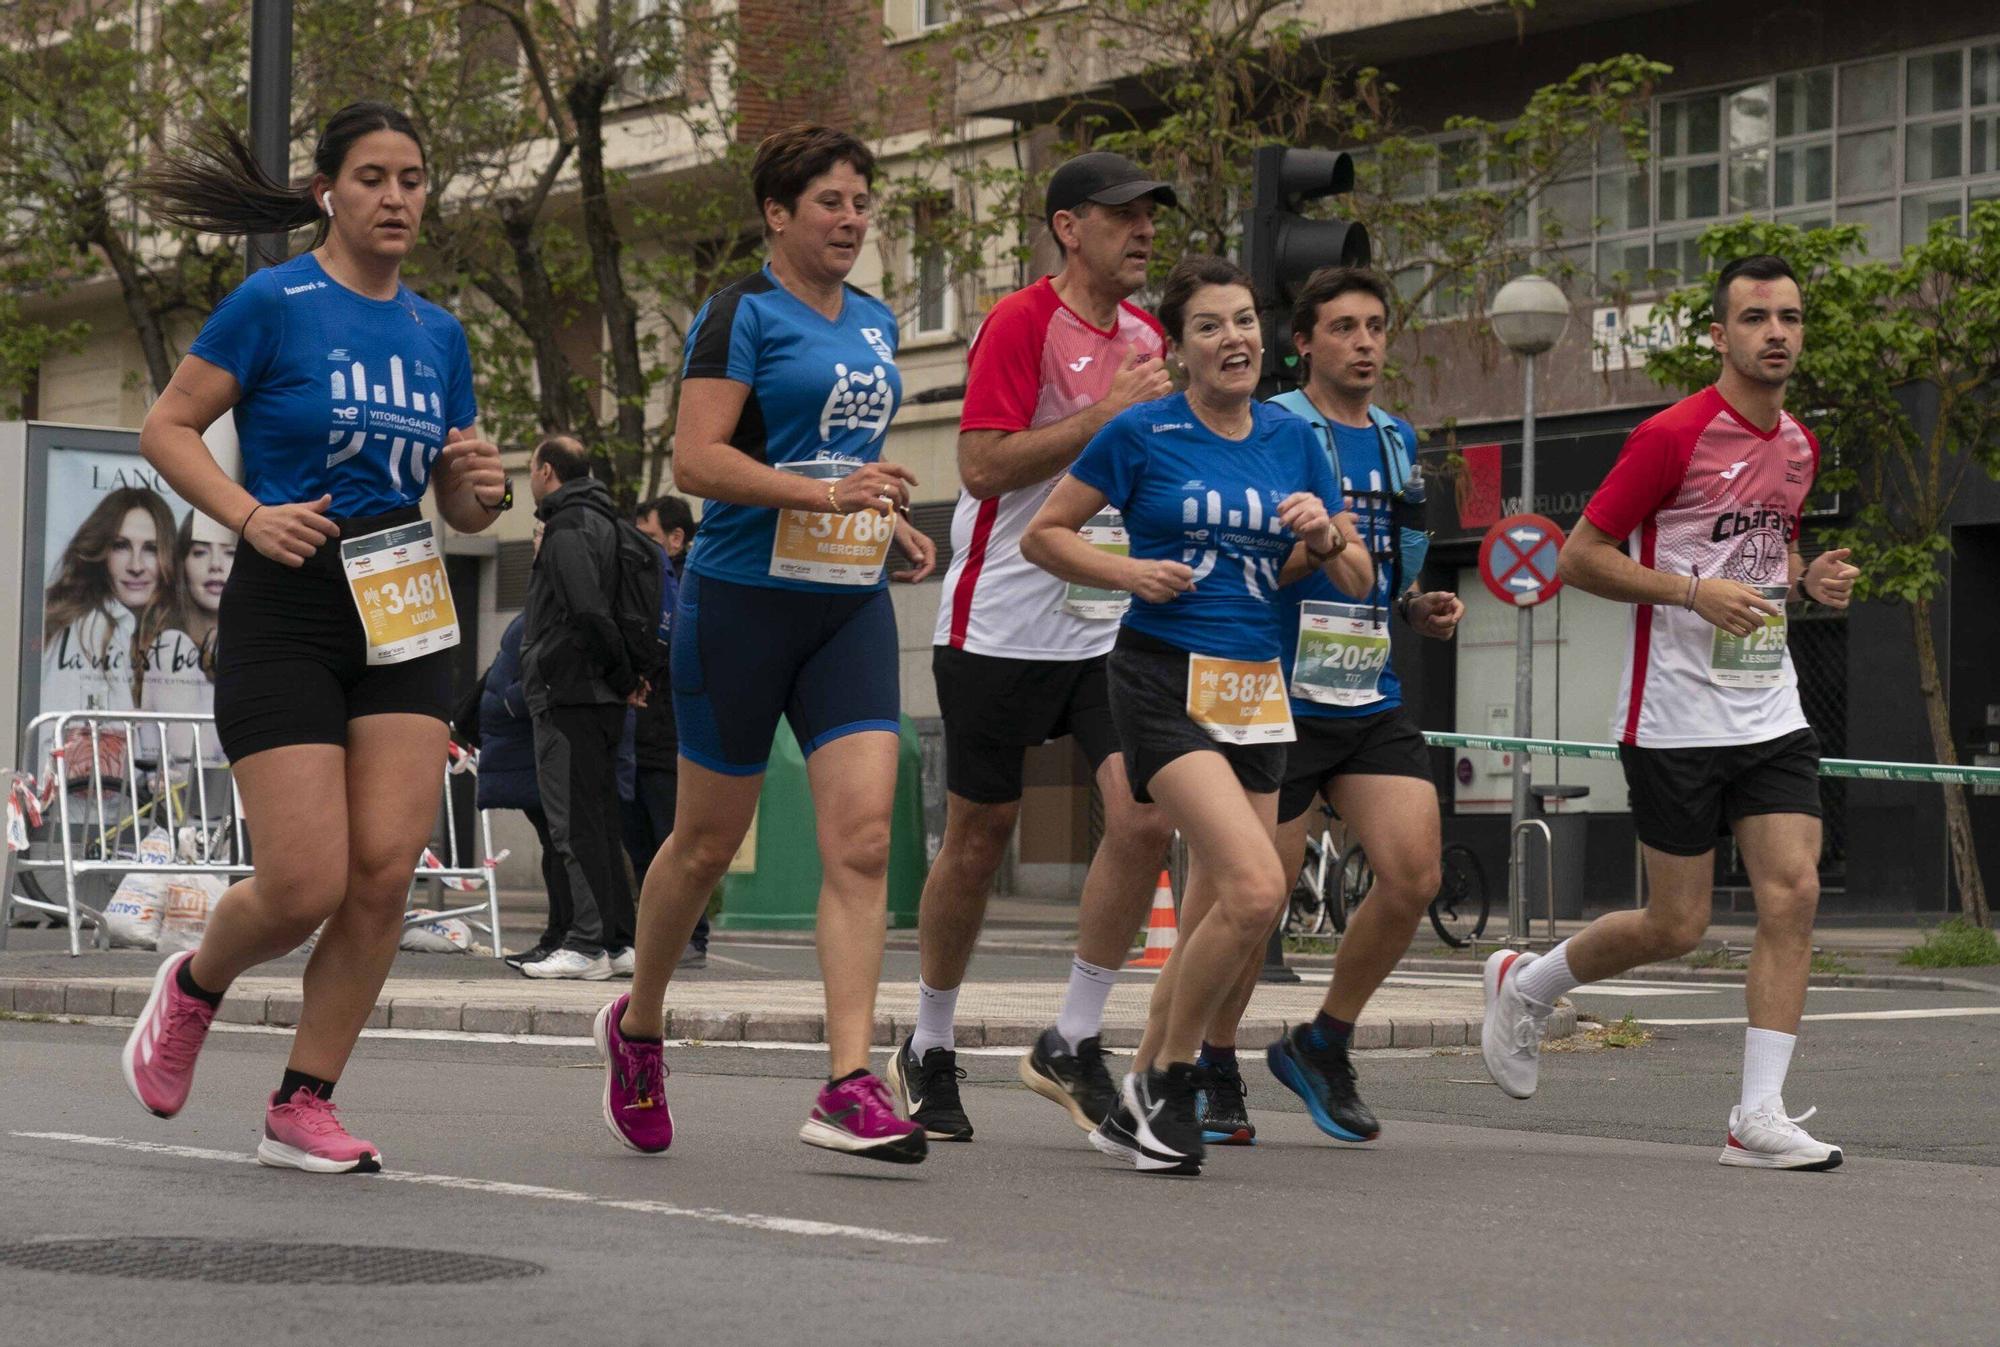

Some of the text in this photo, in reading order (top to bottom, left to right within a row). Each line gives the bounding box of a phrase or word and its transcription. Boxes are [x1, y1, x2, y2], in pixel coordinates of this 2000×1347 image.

[808, 510, 891, 543] 3786
[381, 568, 446, 615] 3481
[1322, 642, 1387, 671] 2054
